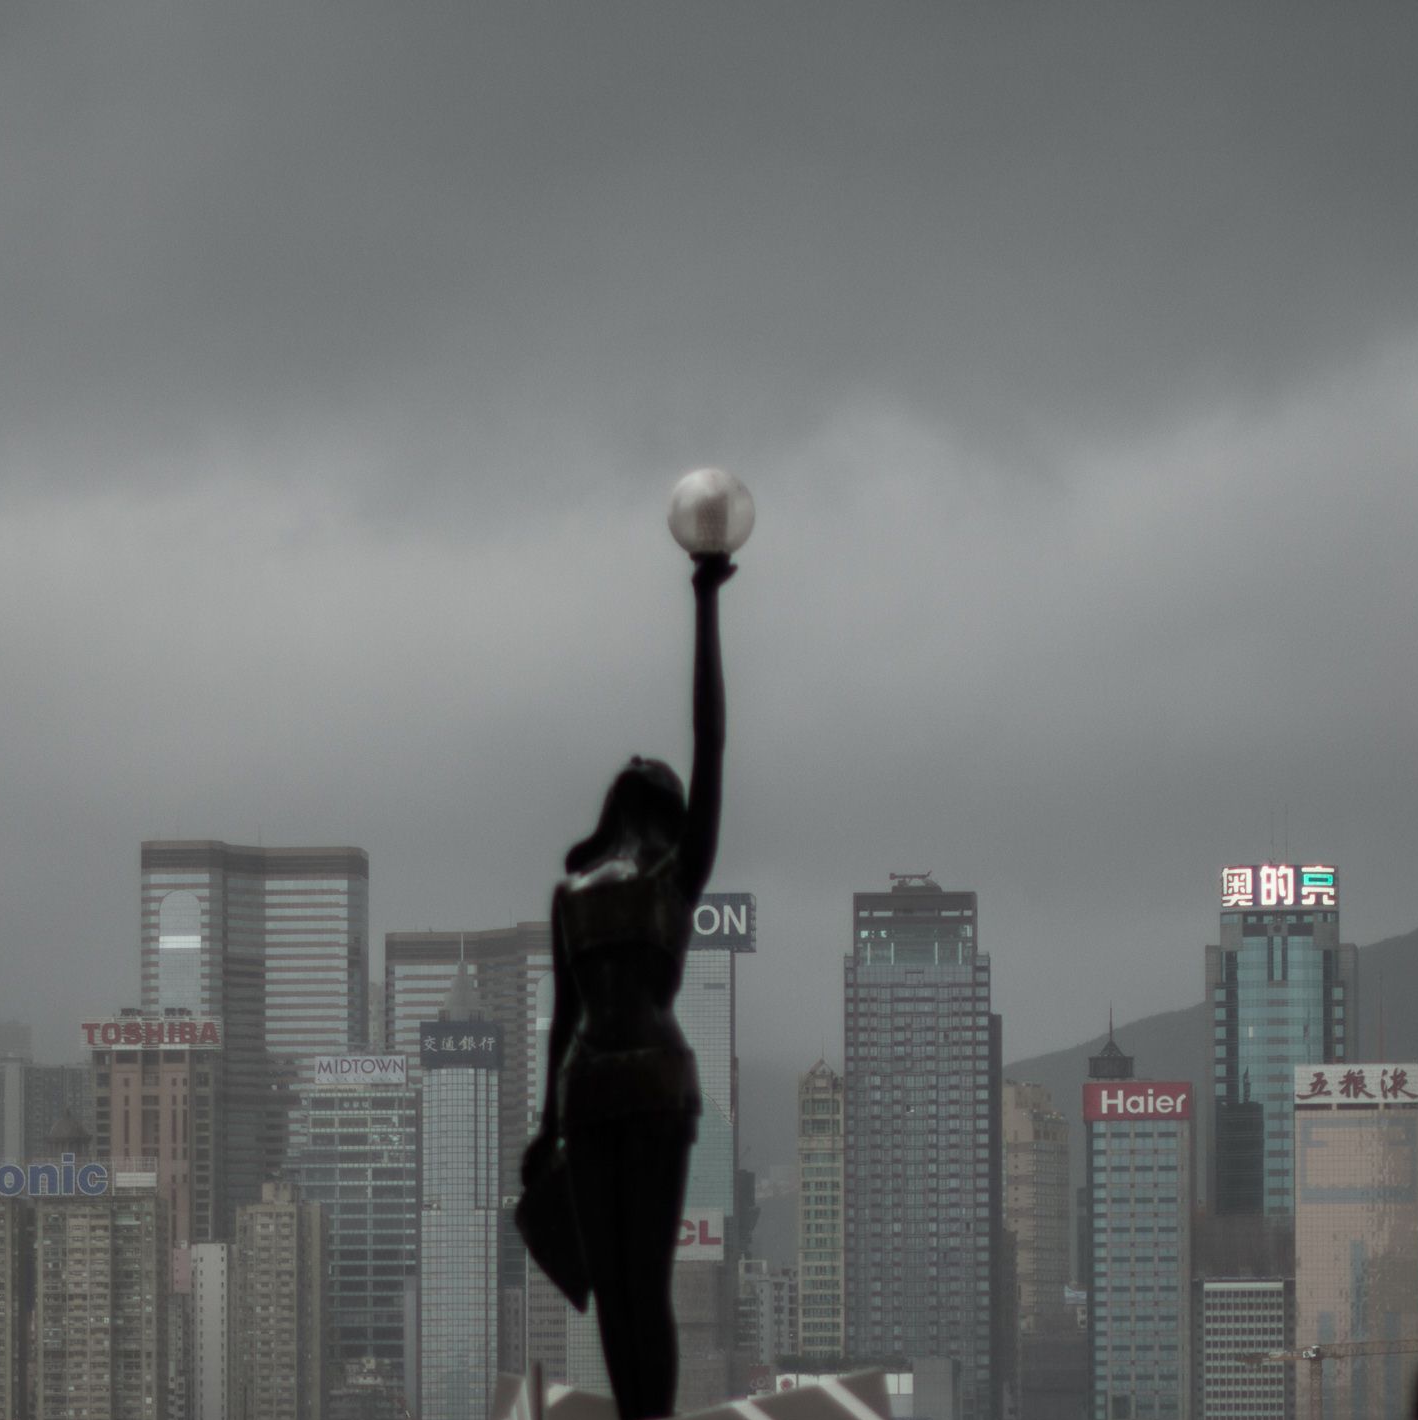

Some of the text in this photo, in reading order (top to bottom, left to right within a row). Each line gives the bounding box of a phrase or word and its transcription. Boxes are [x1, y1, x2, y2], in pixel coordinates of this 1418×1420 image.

[81, 1021, 221, 1045] TOSHIBA
[423, 1034, 497, 1053] 交通銀行
[317, 1058, 404, 1074] MIDTOWN
[1100, 1088, 1187, 1114] Haier
